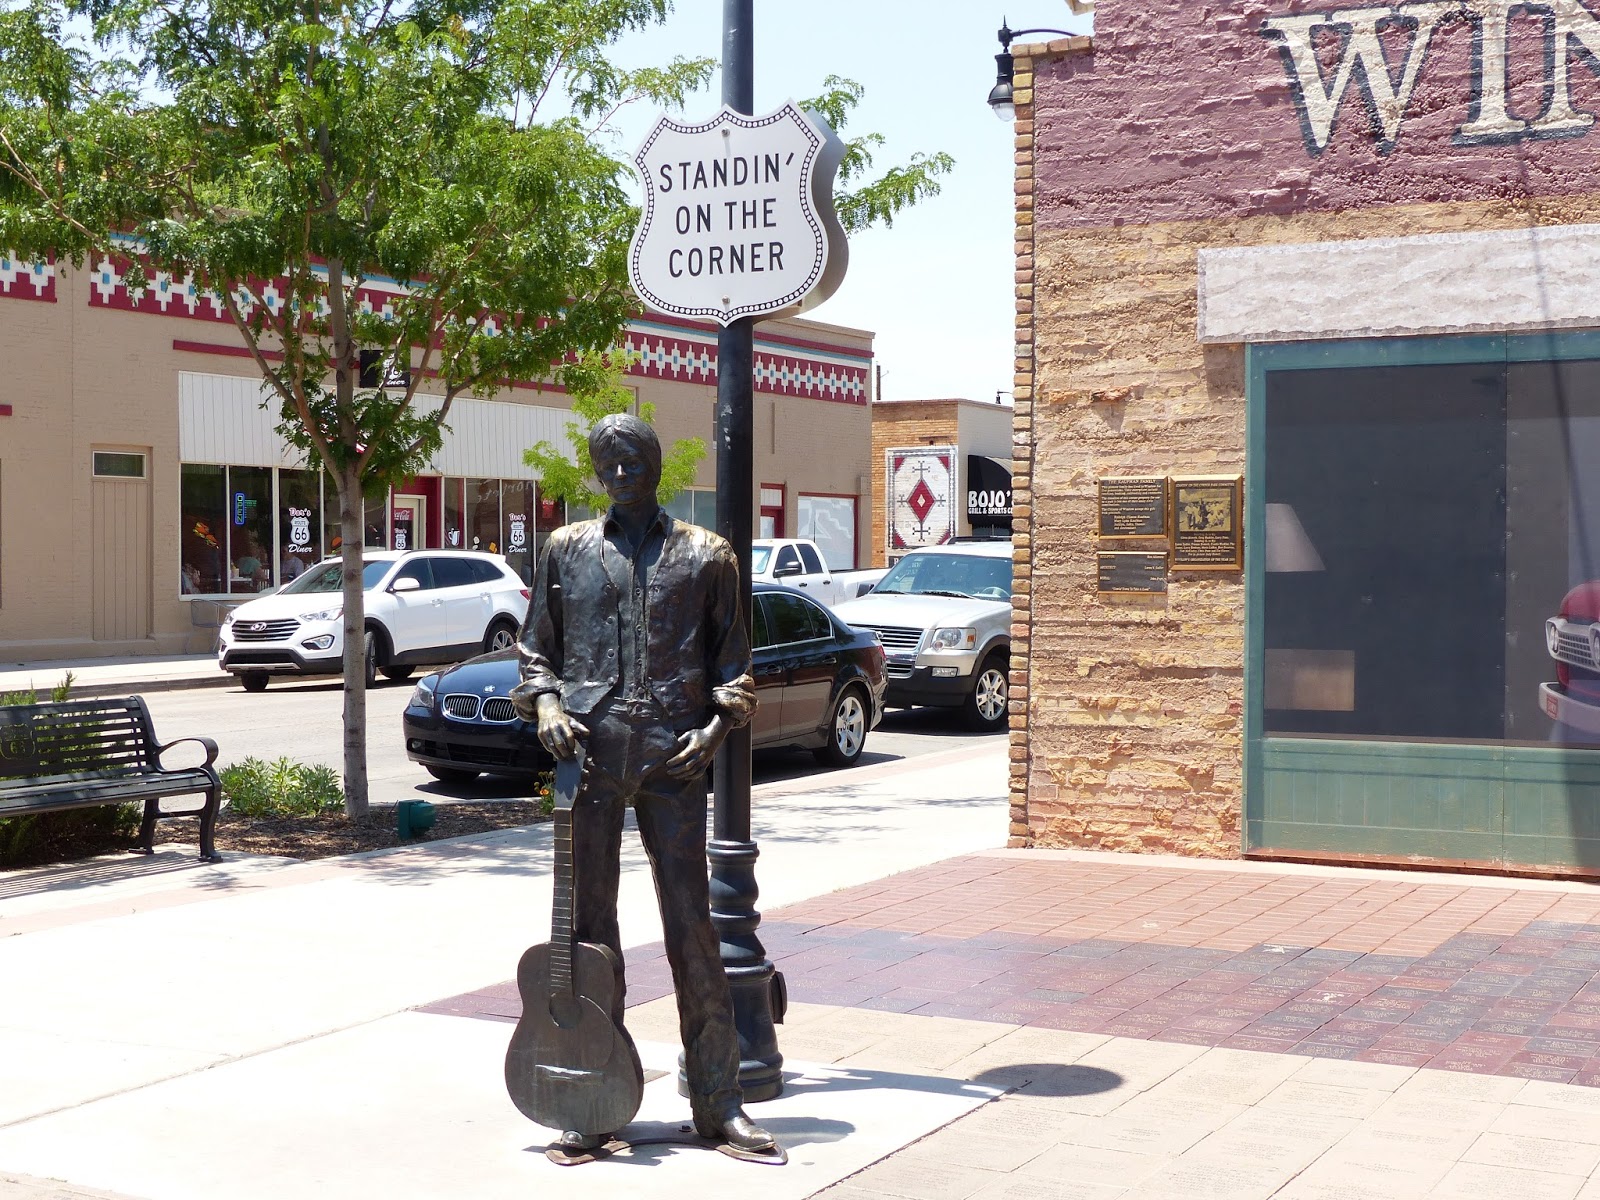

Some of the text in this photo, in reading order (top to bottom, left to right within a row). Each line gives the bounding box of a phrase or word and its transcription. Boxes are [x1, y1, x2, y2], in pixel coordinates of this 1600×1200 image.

[659, 151, 795, 194] STANDIN'
[675, 198, 777, 235] ON THE
[669, 241, 784, 278] CORNER
[968, 490, 1014, 507] BOJO'
[294, 527, 307, 541] 66
[513, 530, 523, 542] 66
[288, 543, 313, 553] Diner
[397, 539, 405, 548] 66
[508, 544, 527, 553] Diner
